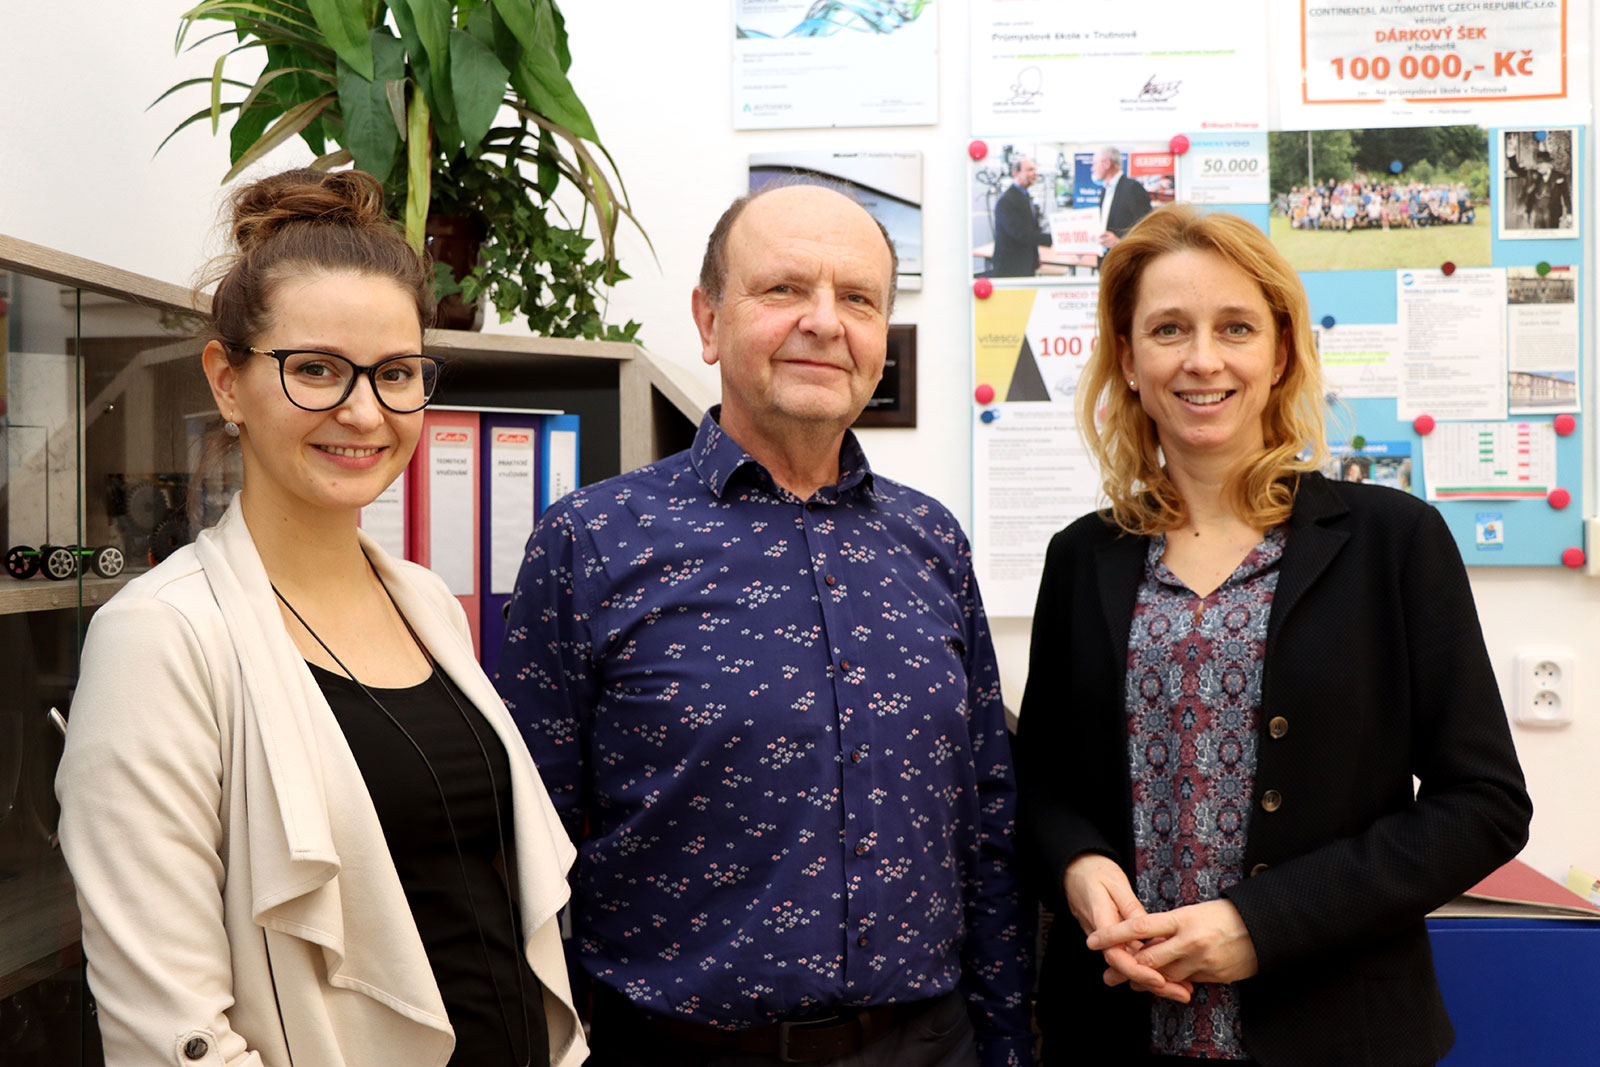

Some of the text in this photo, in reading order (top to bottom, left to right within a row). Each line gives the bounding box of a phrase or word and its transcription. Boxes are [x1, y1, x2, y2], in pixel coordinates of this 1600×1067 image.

[1309, 6, 1376, 17] CONTINENTAL
[1380, 3, 1445, 15] AUTOMOTIVE
[1447, 1, 1480, 12] CZECH
[1415, 16, 1446, 25] věnuje
[1375, 25, 1487, 43] DÁRKOVÝ ŠEK
[1415, 42, 1456, 53] hodnotě
[1330, 49, 1533, 82] 100 000,- Kč
[1203, 158, 1258, 173] 50.000
[1040, 336, 1082, 357] 100
